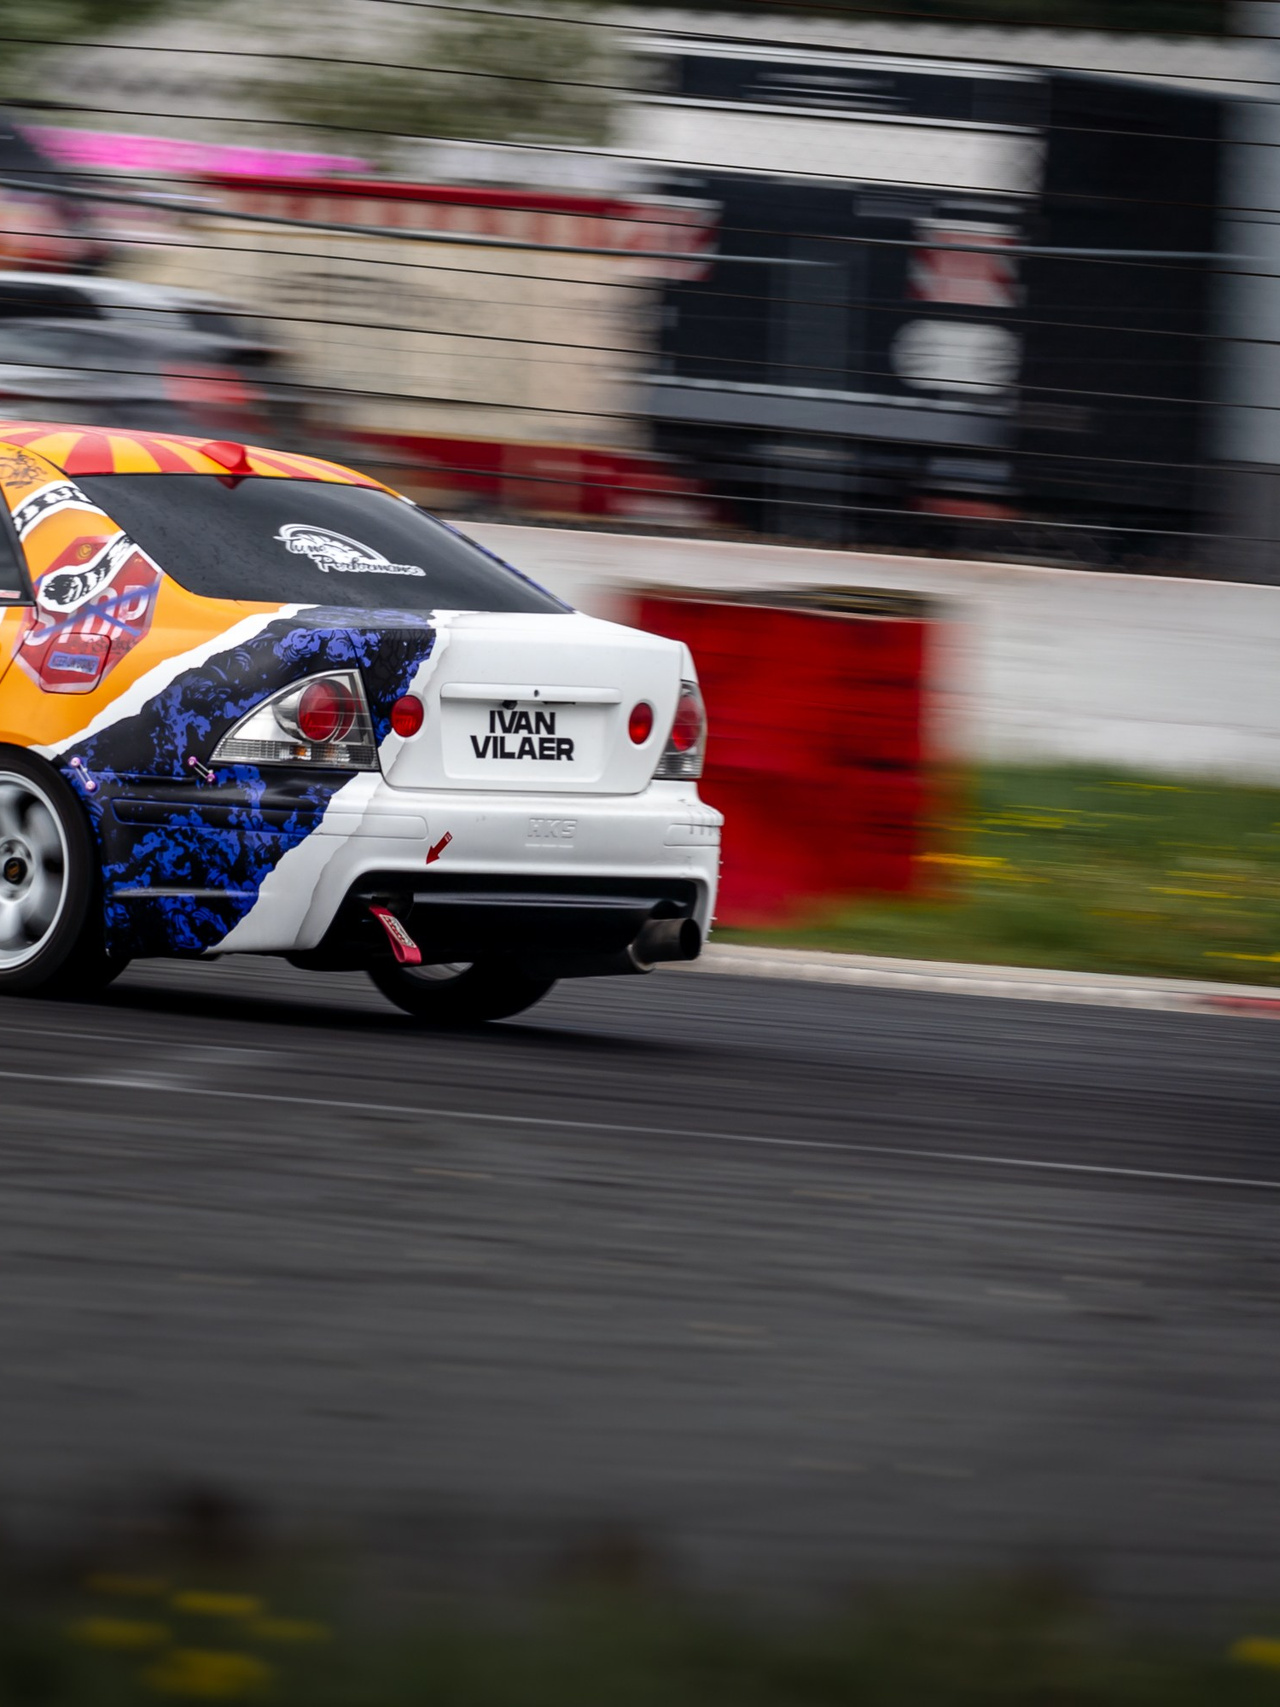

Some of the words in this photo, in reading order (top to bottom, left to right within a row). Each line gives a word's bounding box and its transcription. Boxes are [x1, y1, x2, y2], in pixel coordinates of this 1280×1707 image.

[489, 710, 556, 735] IVAN
[470, 735, 575, 761] VILAER
[527, 817, 578, 838] HKS
